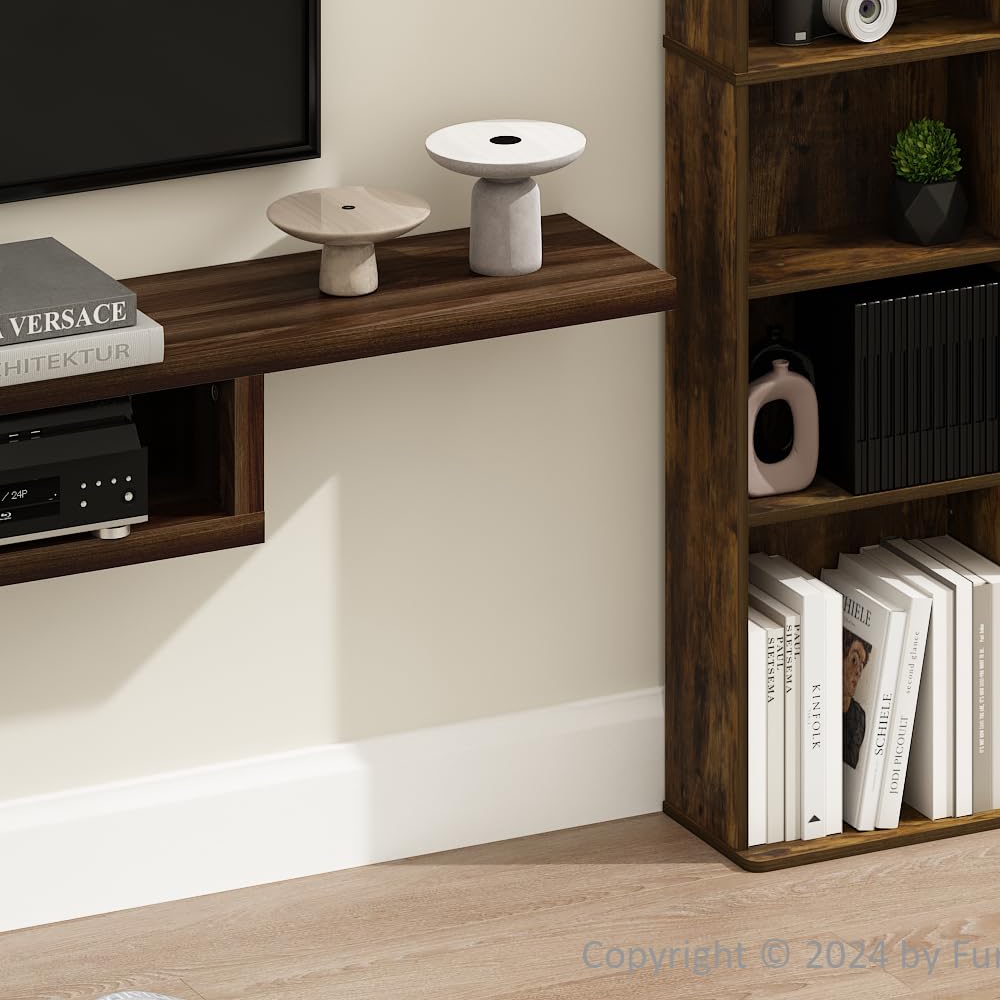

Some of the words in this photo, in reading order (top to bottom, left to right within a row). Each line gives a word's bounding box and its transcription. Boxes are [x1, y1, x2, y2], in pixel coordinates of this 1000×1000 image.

[9, 300, 127, 337] VERSACE
[843, 596, 872, 628] HIELE
[767, 637, 775, 703] SIETSEMA
[776, 637, 784, 671] PAUL
[905, 662, 916, 694] second
[812, 684, 821, 749] KINFOLK
[874, 692, 892, 756] SCHIELE
[893, 715, 909, 765] PICOULT
[889, 769, 900, 794] JODI
